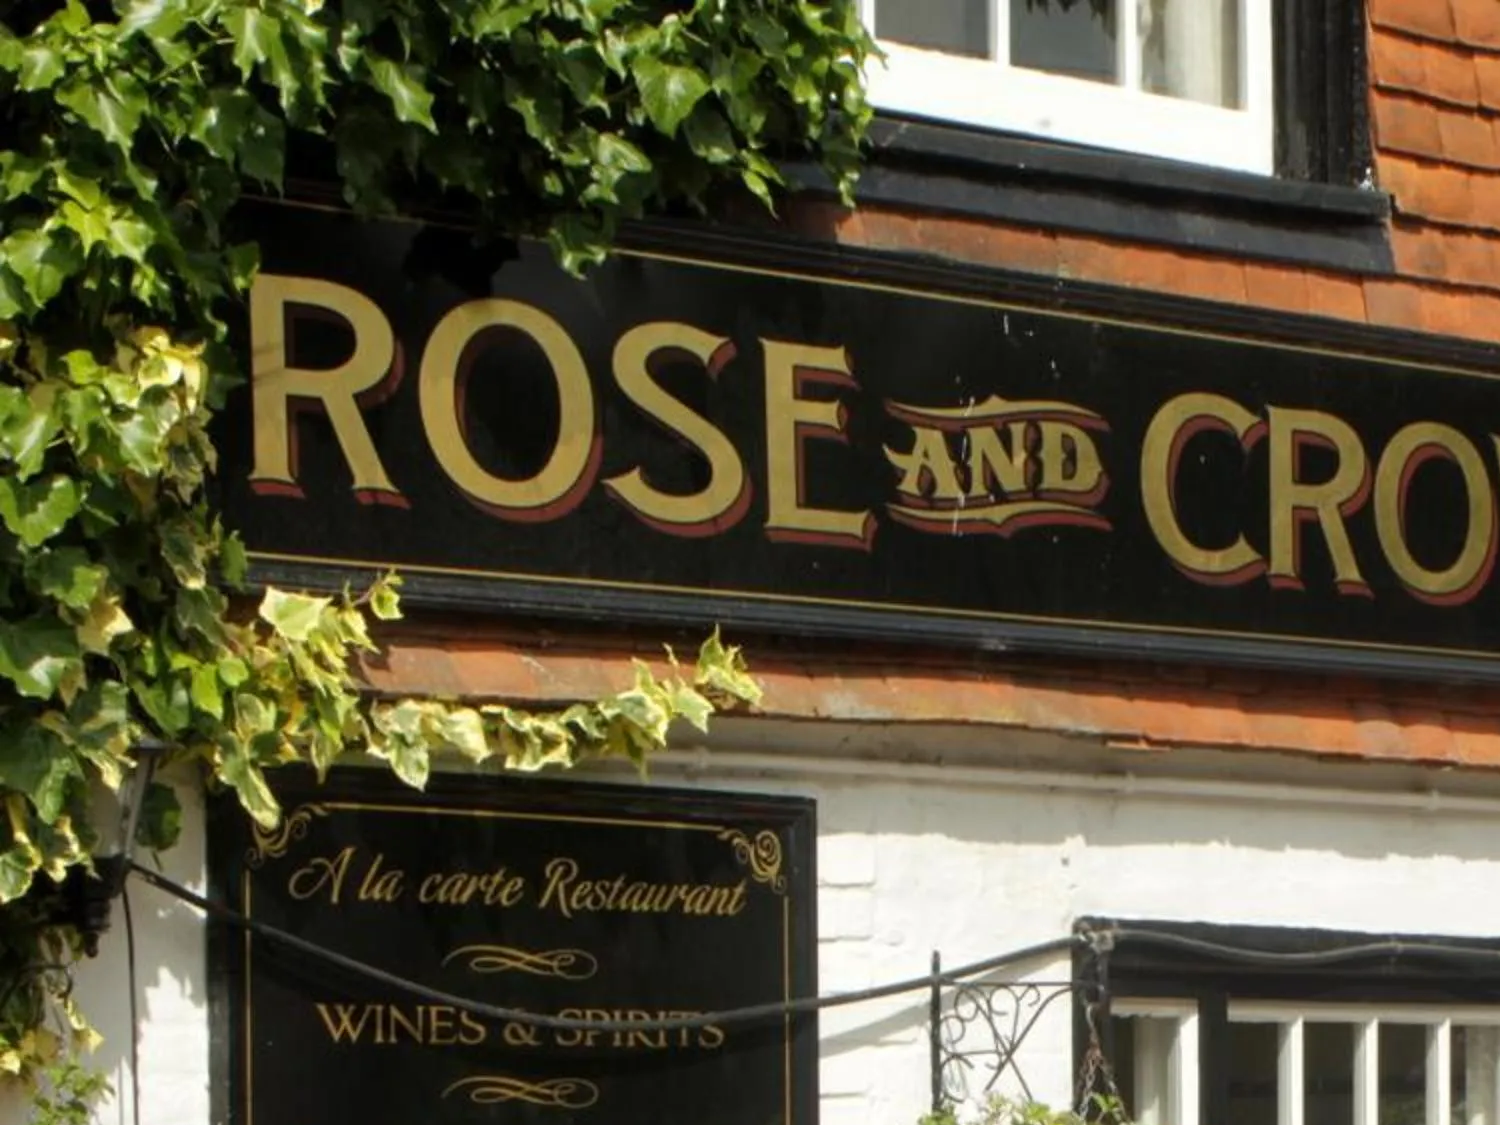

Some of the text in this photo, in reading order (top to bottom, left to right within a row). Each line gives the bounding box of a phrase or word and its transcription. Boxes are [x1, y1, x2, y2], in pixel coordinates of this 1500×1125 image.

[249, 274, 877, 551] ROSE
[883, 420, 1108, 508] AND
[288, 847, 748, 918] A la carte Restaurant
[315, 1002, 725, 1048] WINES & SPIRITS
